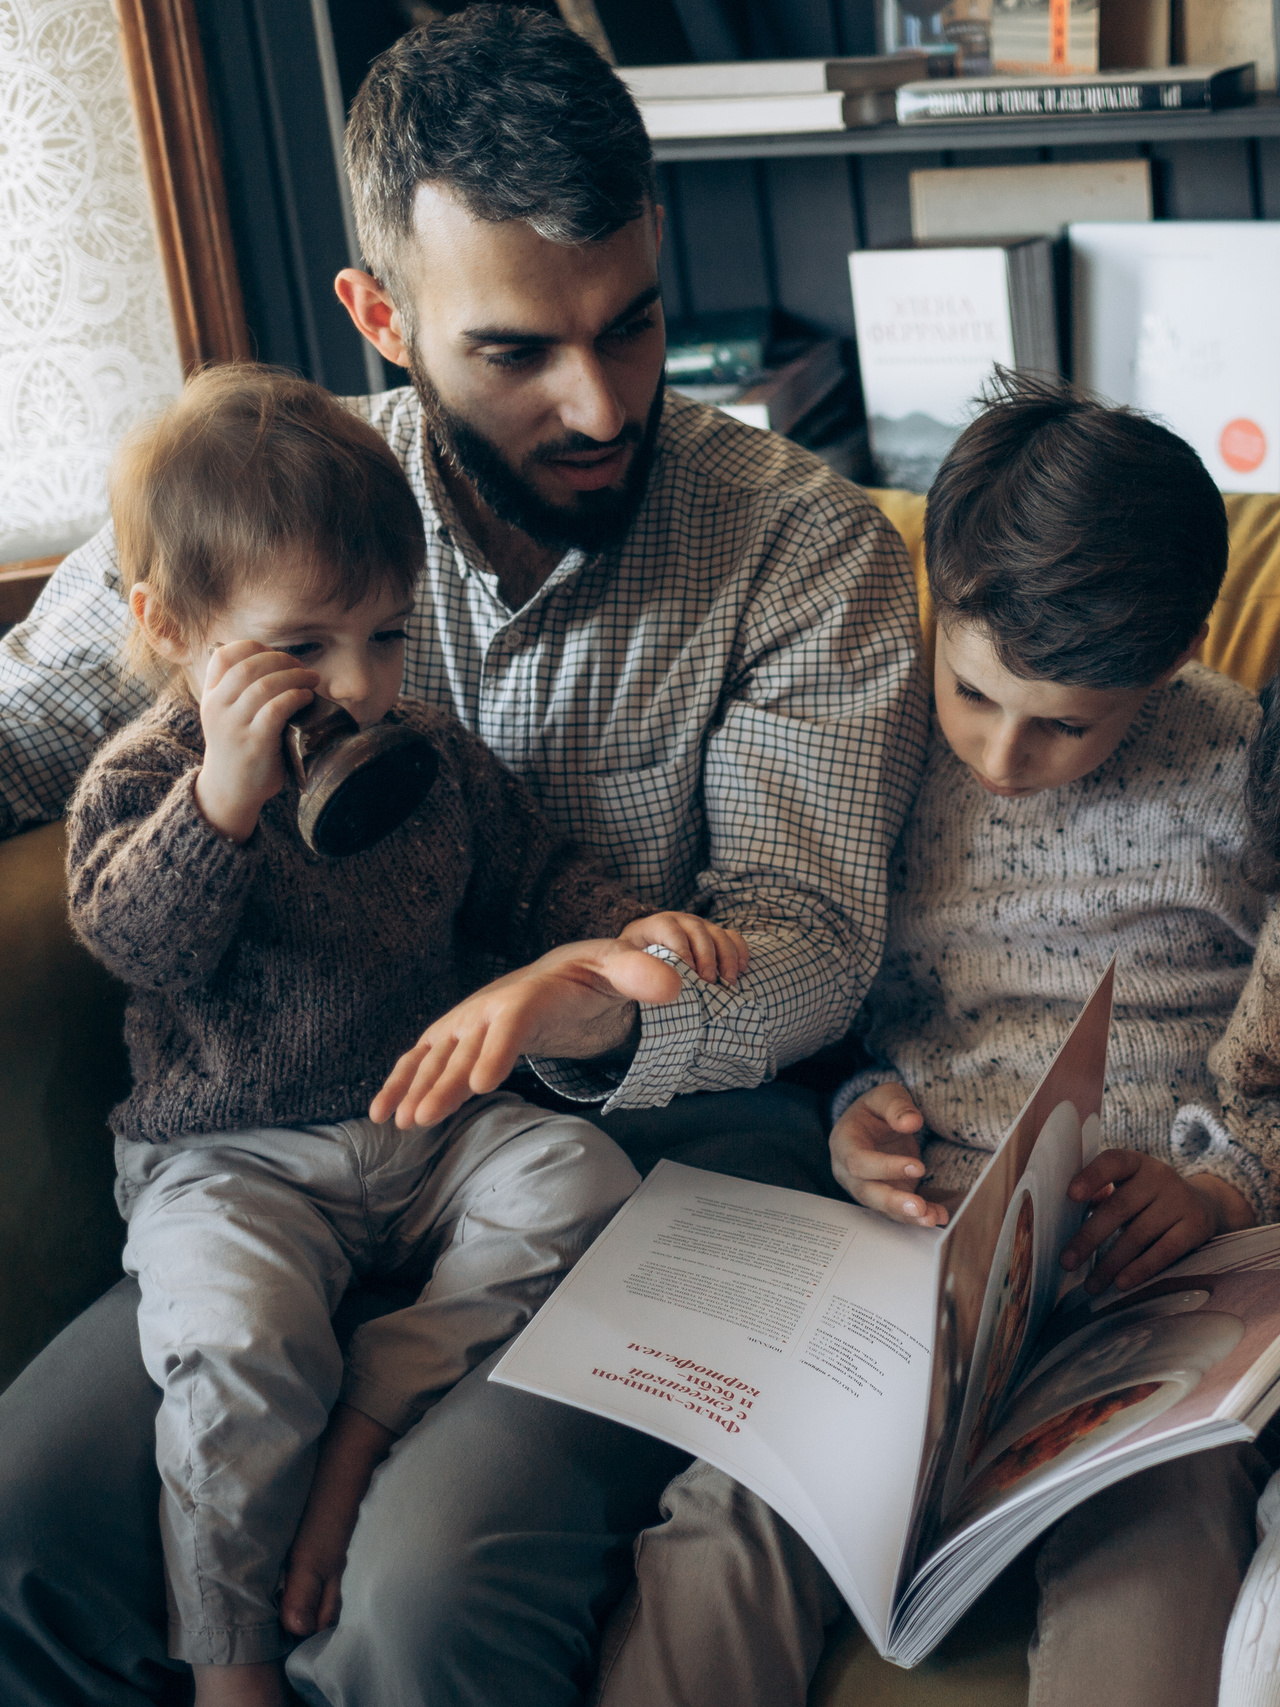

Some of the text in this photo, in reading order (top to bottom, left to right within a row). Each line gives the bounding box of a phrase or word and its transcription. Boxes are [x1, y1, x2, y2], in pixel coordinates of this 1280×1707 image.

[626, 1342, 761, 1397] картофелем
[628, 1367, 748, 1421] с ежевикой
[677, 1373, 754, 1409] и беби-
[591, 1368, 741, 1434] Филе-миньон
